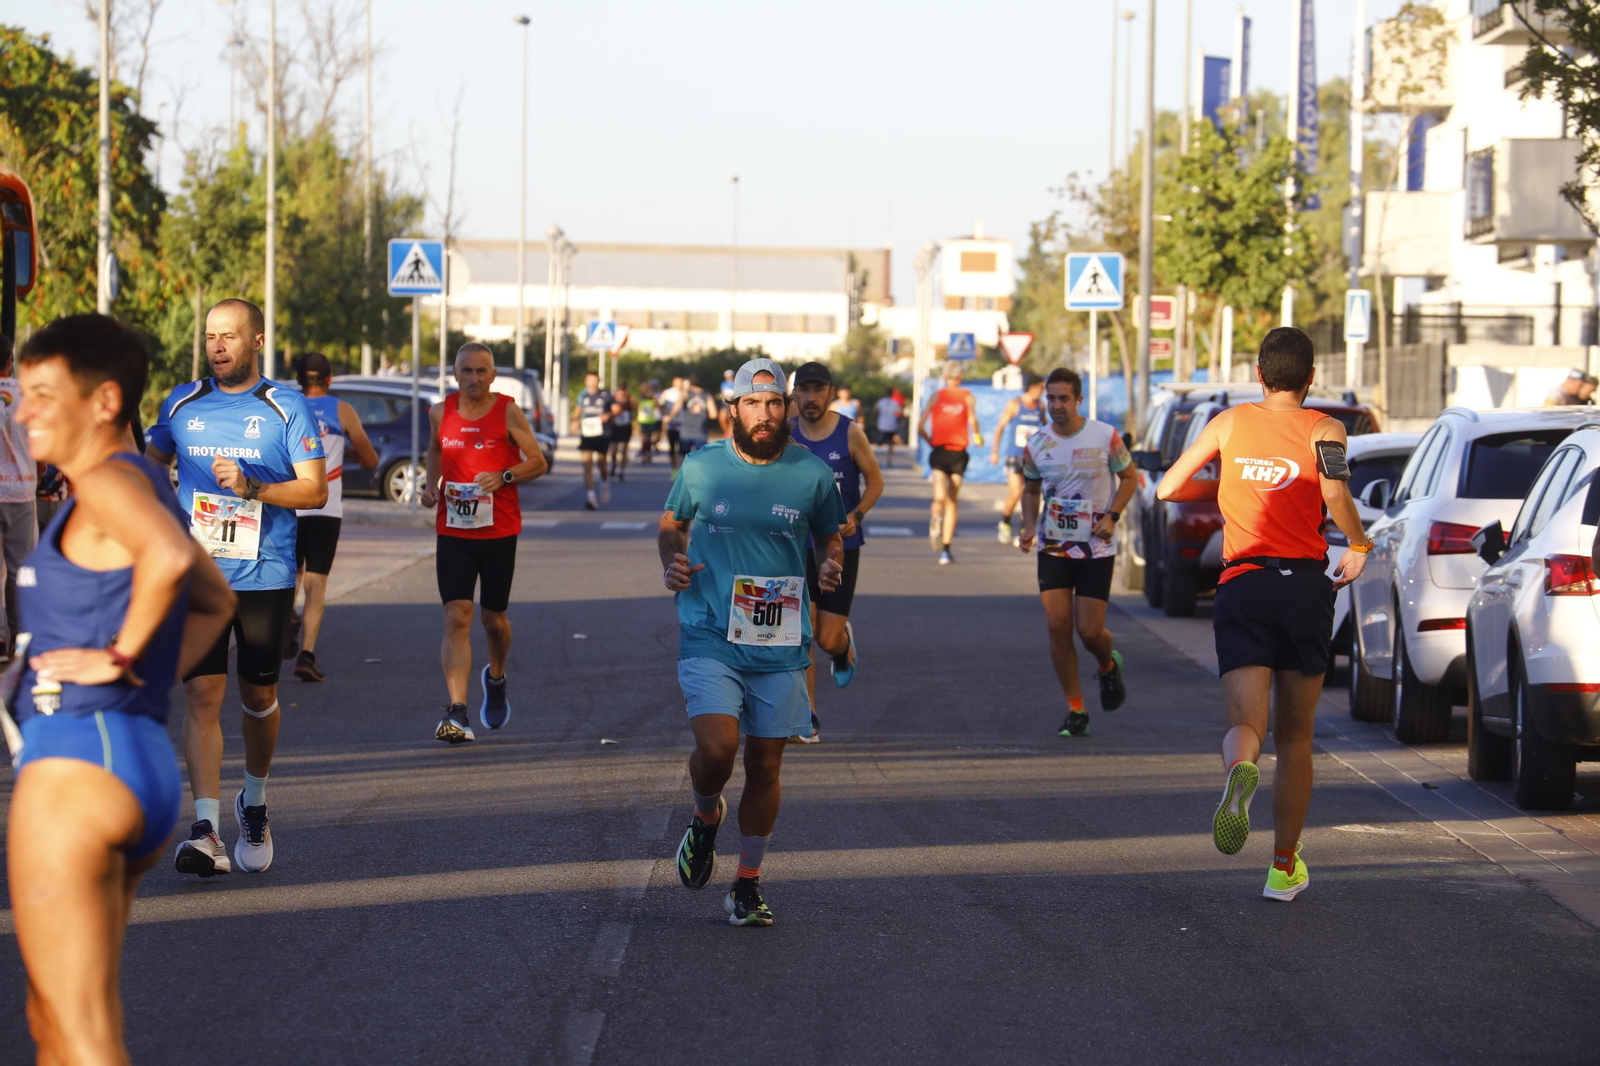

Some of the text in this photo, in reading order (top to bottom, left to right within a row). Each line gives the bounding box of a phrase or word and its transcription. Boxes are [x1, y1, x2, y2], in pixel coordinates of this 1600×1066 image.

[187, 446, 261, 459] TROTASIERRA
[1234, 457, 1274, 467] NOCTURNA
[455, 499, 479, 516] 267
[1058, 514, 1078, 530] 515
[208, 518, 237, 543] 211
[753, 601, 783, 627] 501
